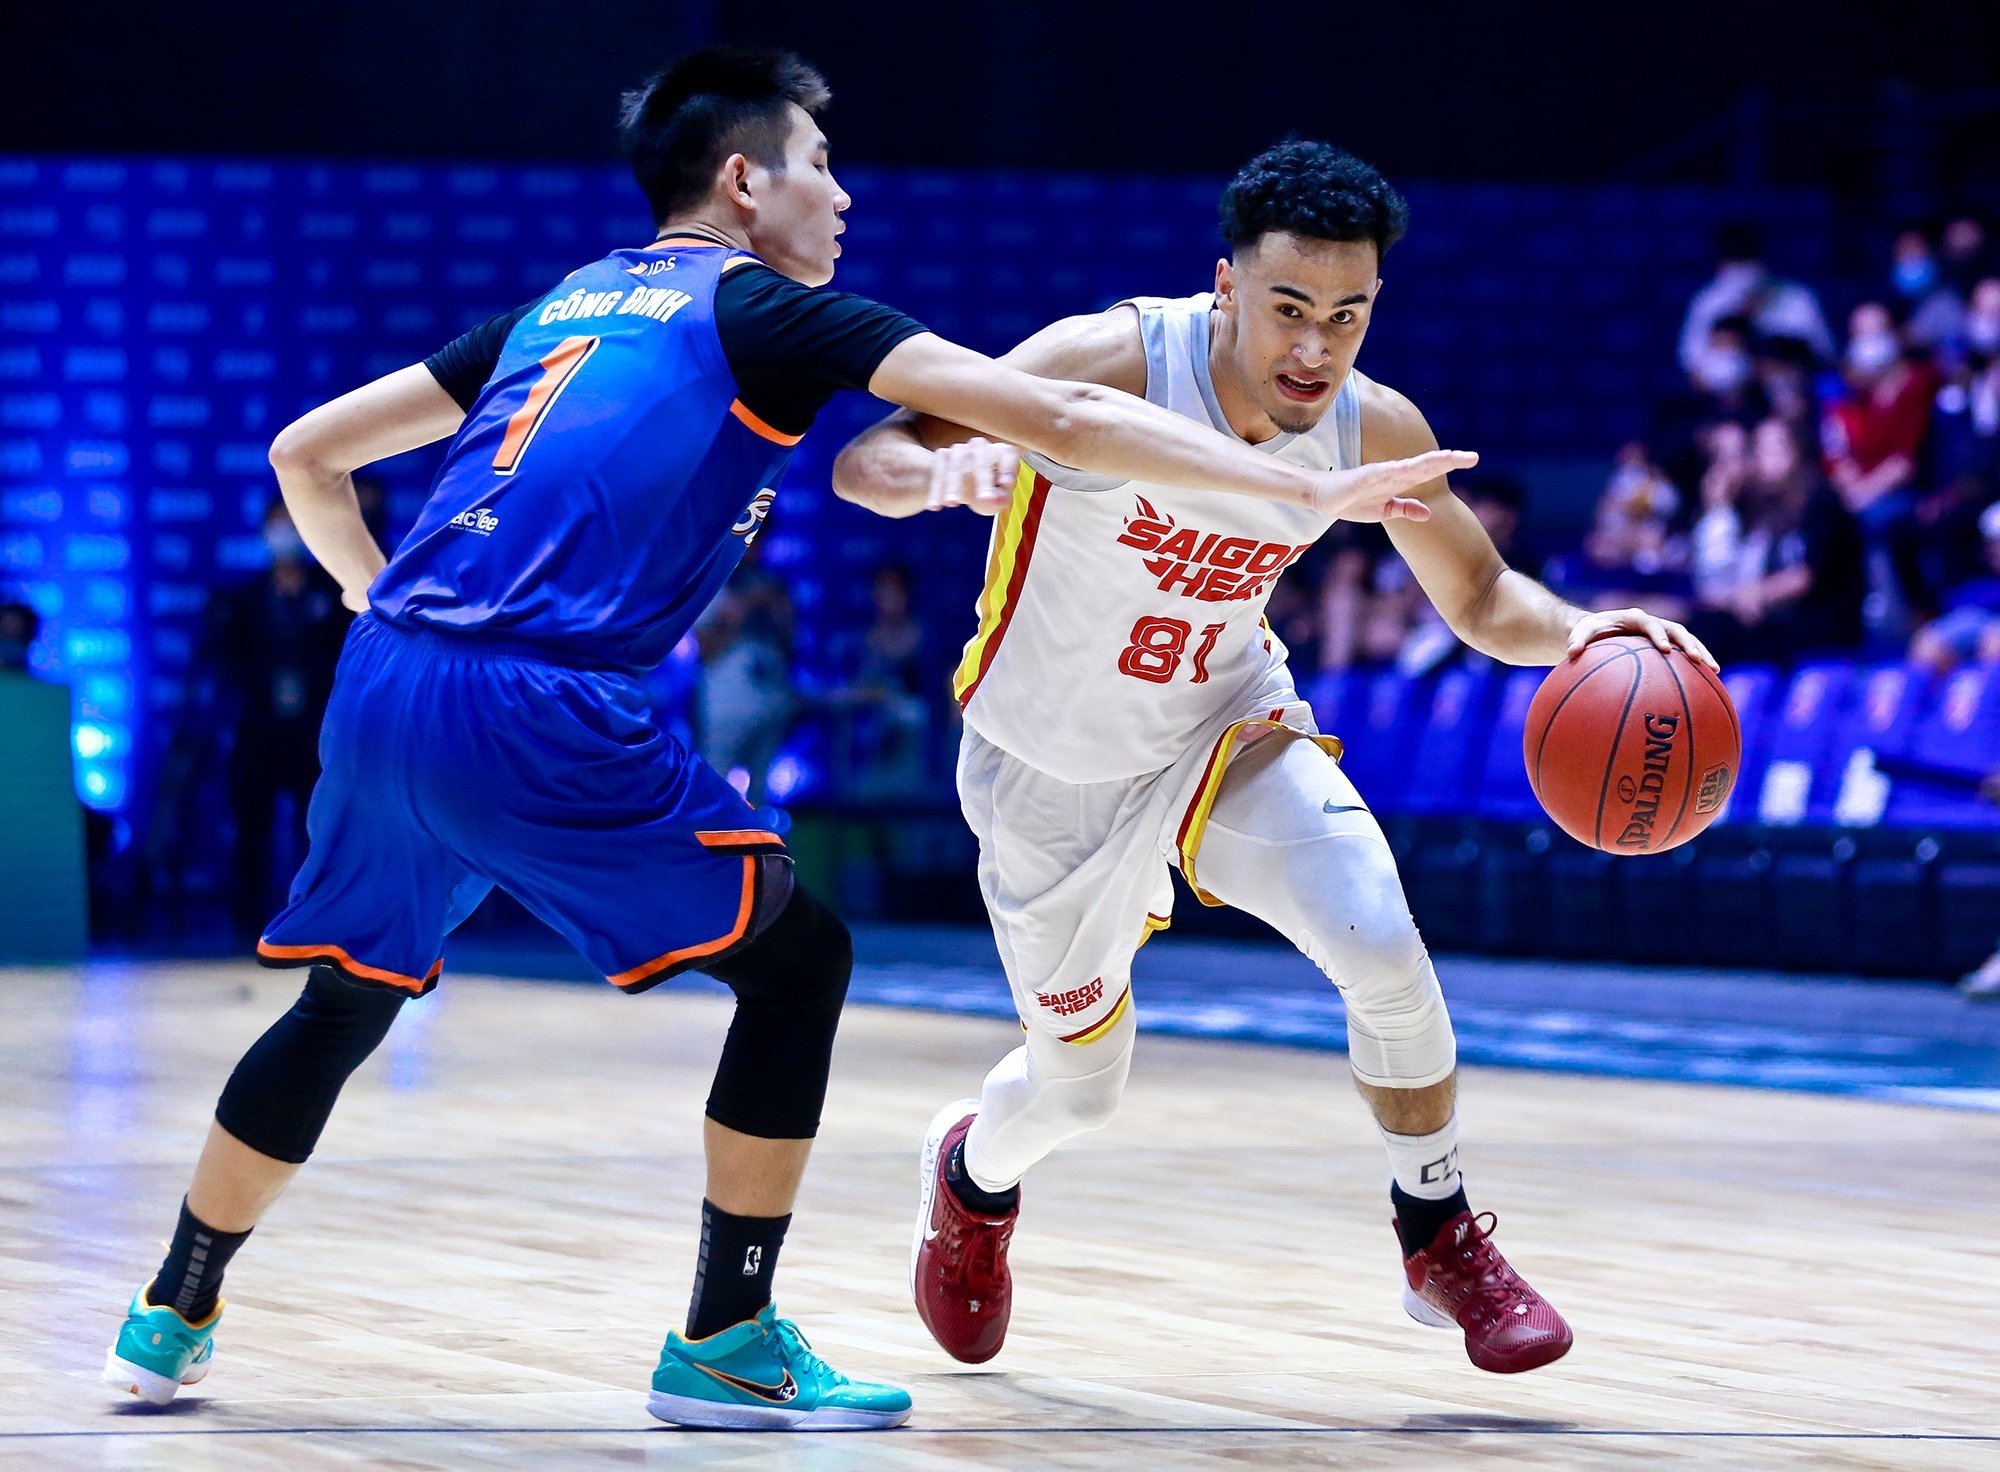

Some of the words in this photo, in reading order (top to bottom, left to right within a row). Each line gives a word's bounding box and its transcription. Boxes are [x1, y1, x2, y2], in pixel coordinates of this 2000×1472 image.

[647, 256, 677, 277] IDS
[538, 288, 624, 326] CÔNG
[492, 335, 601, 476] 1
[1117, 615, 1228, 684] 81
[1616, 712, 1680, 849] SPALDING
[1699, 770, 1720, 810] VBA
[1038, 976, 1102, 1007] SAIGON
[1058, 984, 1104, 1017] HEAT
